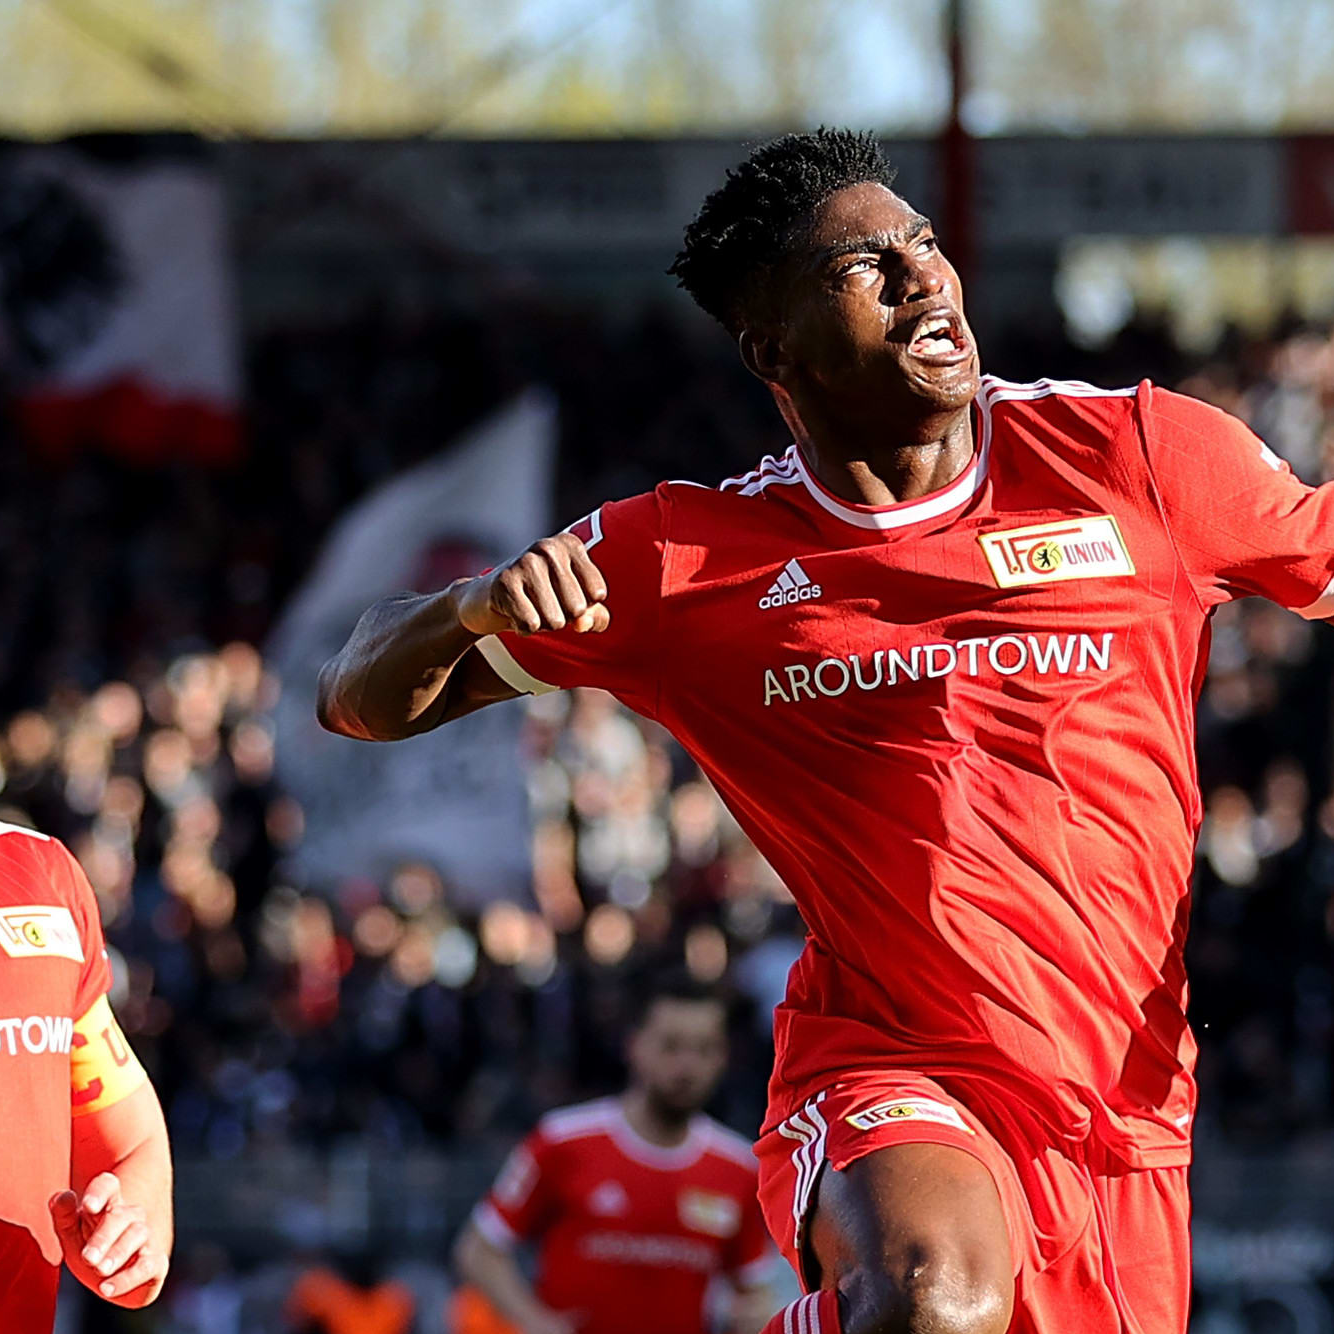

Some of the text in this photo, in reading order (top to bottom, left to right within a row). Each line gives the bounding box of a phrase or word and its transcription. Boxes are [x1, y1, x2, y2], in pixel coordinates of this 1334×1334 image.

[1063, 540, 1116, 565] UNION
[758, 584, 822, 609] adidas
[763, 632, 1114, 706] AROUNDTOWN
